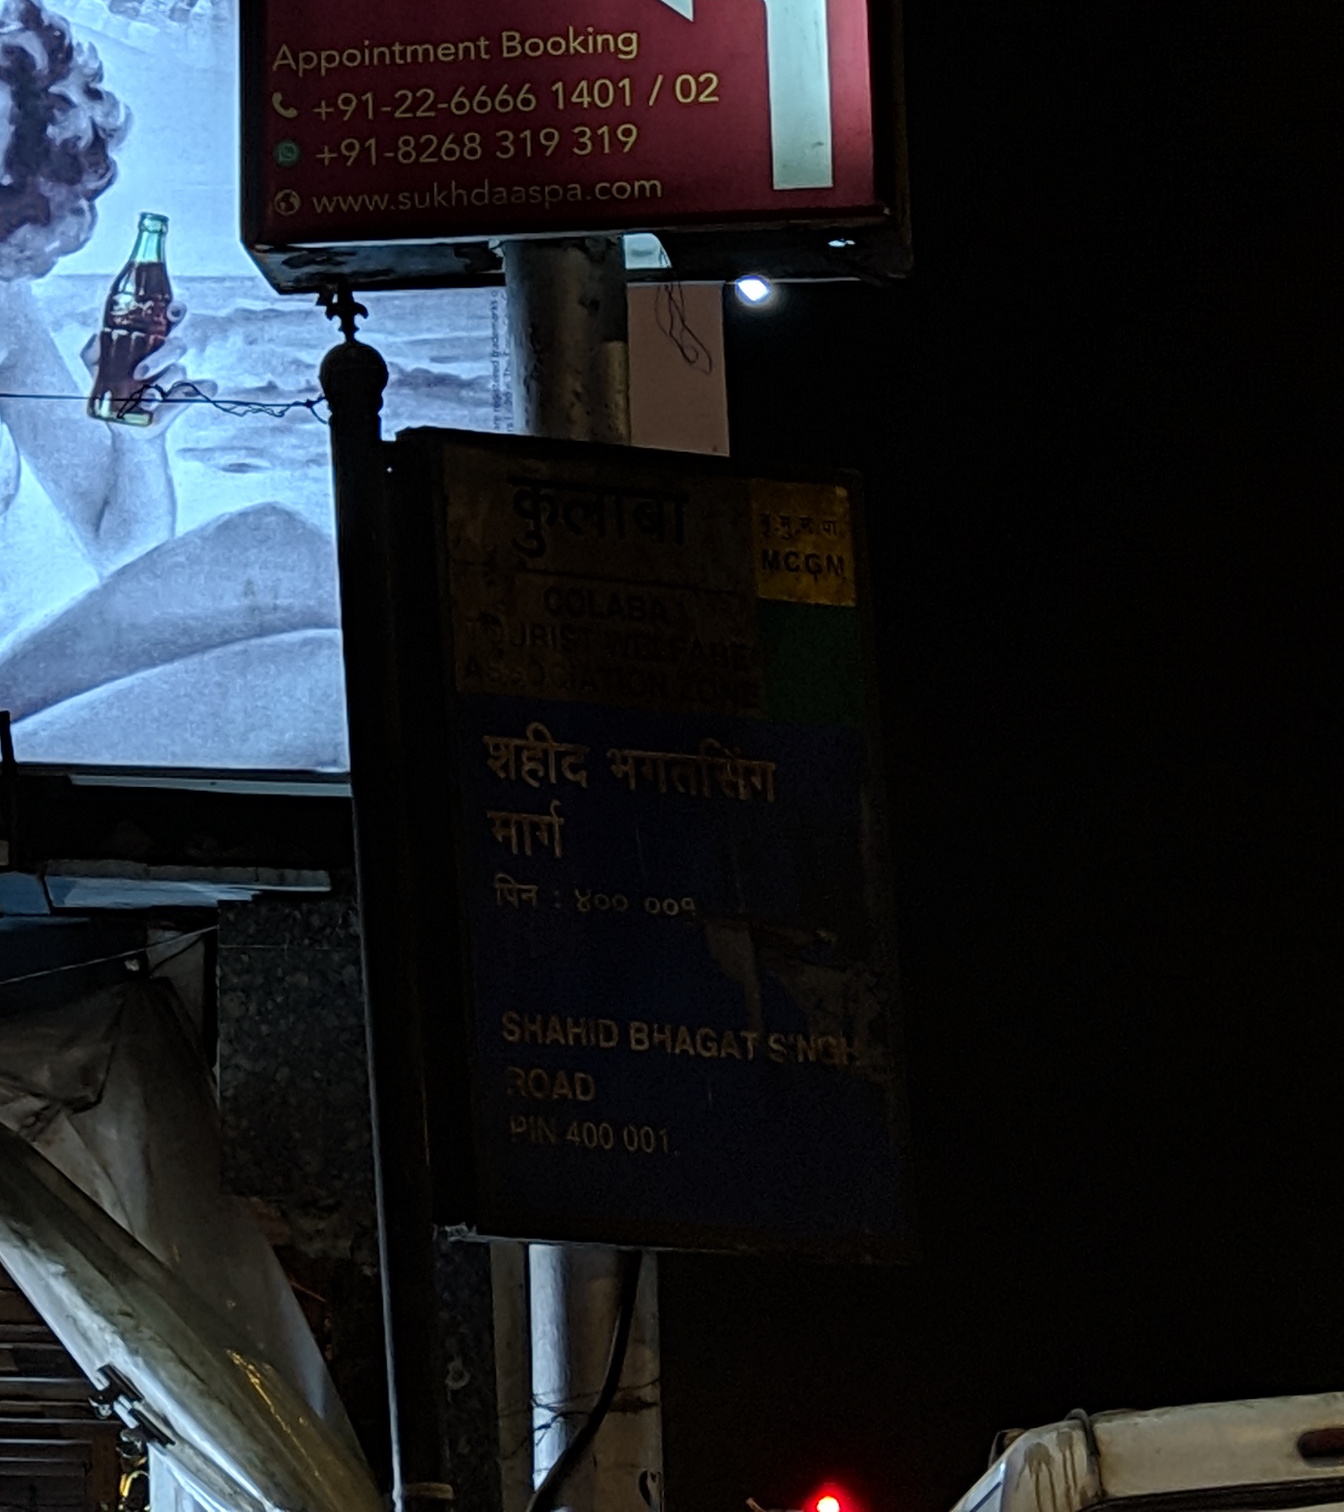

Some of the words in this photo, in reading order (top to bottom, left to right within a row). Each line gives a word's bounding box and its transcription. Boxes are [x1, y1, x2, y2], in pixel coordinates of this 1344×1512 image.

[272, 34, 490, 77] Appointment
[501, 26, 639, 60] Booking
[312, 83, 537, 122] +91-22-6666
[551, 76, 633, 111] 1401
[647, 74, 664, 108] /
[673, 72, 720, 104] 02
[316, 131, 483, 168] +91-8268
[495, 126, 561, 160] 319
[572, 123, 639, 156] 319
[312, 177, 664, 215] www.sukhdaaspa.com
[543, 585, 670, 623] COLABA
[482, 720, 591, 789] शहीद
[485, 799, 566, 859] मार्ग
[499, 1009, 621, 1050] SHAHID
[627, 1019, 760, 1062] BHAGAT
[504, 1065, 598, 1103] ROAD
[508, 1114, 559, 1147] PIN
[565, 1121, 615, 1153] 400
